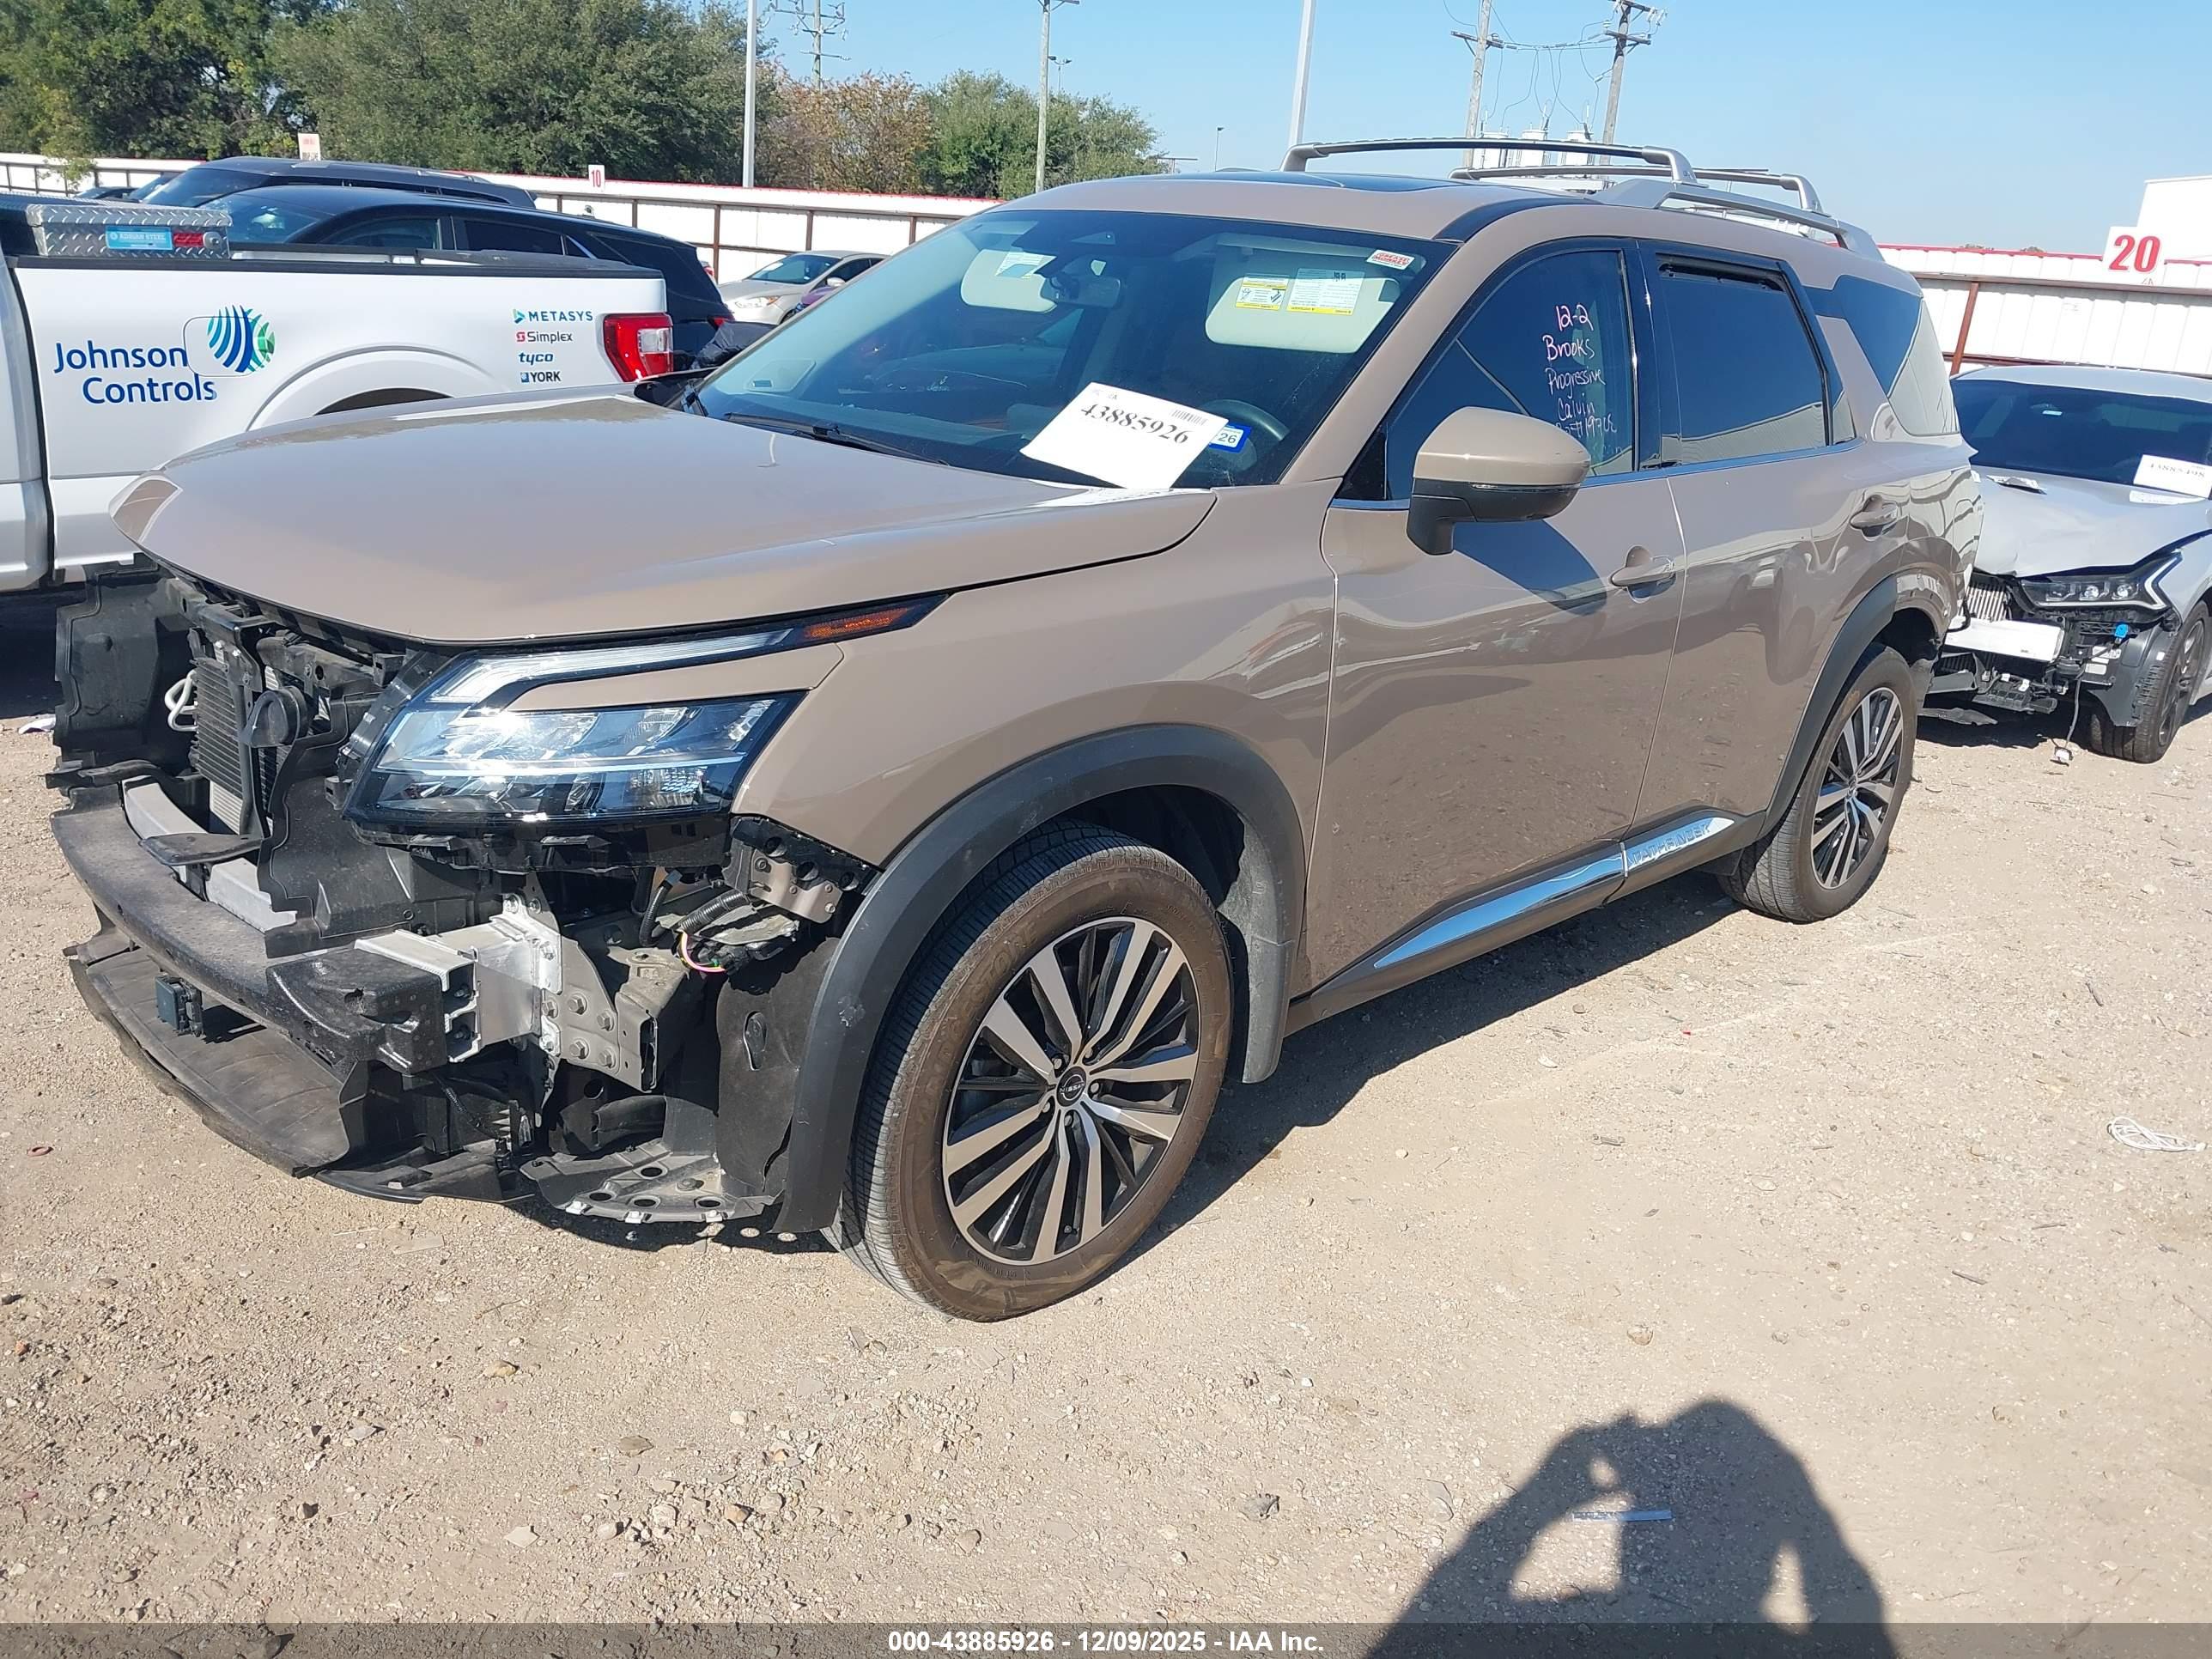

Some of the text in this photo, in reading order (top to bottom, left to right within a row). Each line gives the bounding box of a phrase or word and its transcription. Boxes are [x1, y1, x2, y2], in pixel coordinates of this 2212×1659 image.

[591, 169, 601, 187] 10
[2108, 234, 2160, 273] 20
[528, 310, 593, 322] METASYS
[1555, 304, 1594, 331] 12-2
[527, 331, 573, 344] Simplex
[53, 339, 188, 374] Johnson
[519, 352, 554, 366] tyco
[530, 370, 561, 383] YORK
[82, 373, 218, 405] Controls
[1080, 403, 1195, 445] 43885926
[1217, 432, 1238, 445] 26
[1631, 824, 1711, 864] PATHFINDER
